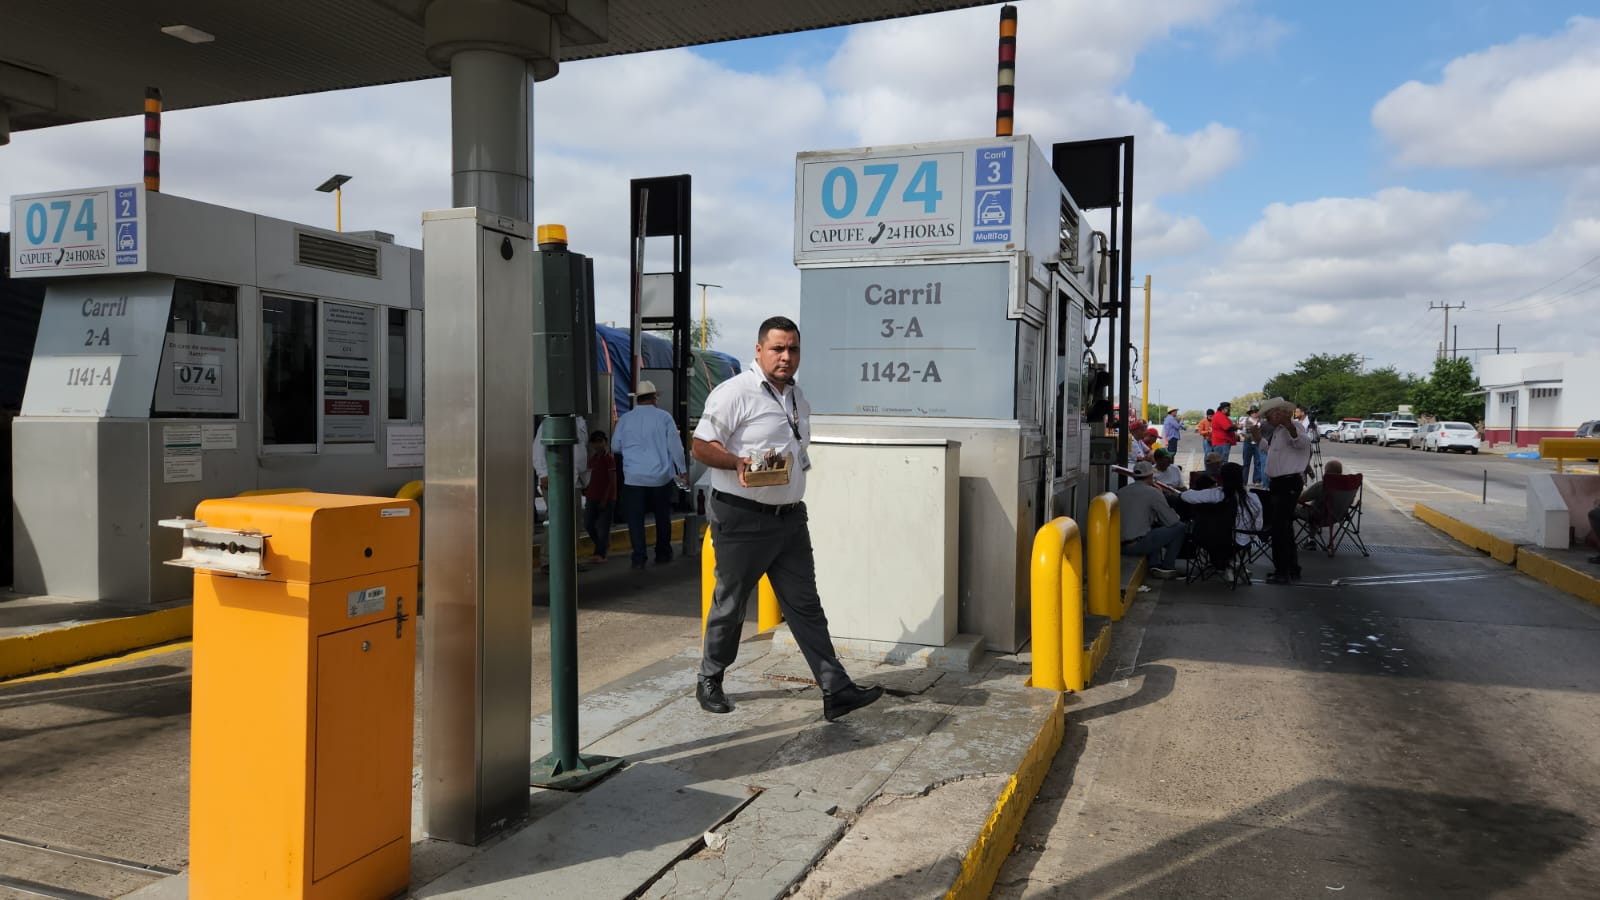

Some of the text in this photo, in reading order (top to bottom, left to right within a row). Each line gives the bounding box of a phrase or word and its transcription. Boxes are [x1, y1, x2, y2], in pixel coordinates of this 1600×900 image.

[984, 151, 1006, 160] Carril
[987, 161, 1001, 183] 3
[821, 160, 943, 220] 074
[121, 199, 131, 217] 2
[26, 198, 97, 245] 074
[809, 223, 955, 243] CAPUFE 24 HORAS
[975, 231, 1009, 241] MultiTag
[20, 249, 106, 265] CAPUFE 24 HORAS
[864, 282, 942, 305] Carril
[82, 296, 128, 317] Carril
[84, 327, 111, 346] 2-A
[880, 316, 924, 338] 3-A
[66, 366, 112, 387] 1141-A
[180, 365, 217, 385] 074
[860, 360, 942, 383] 1142-A
